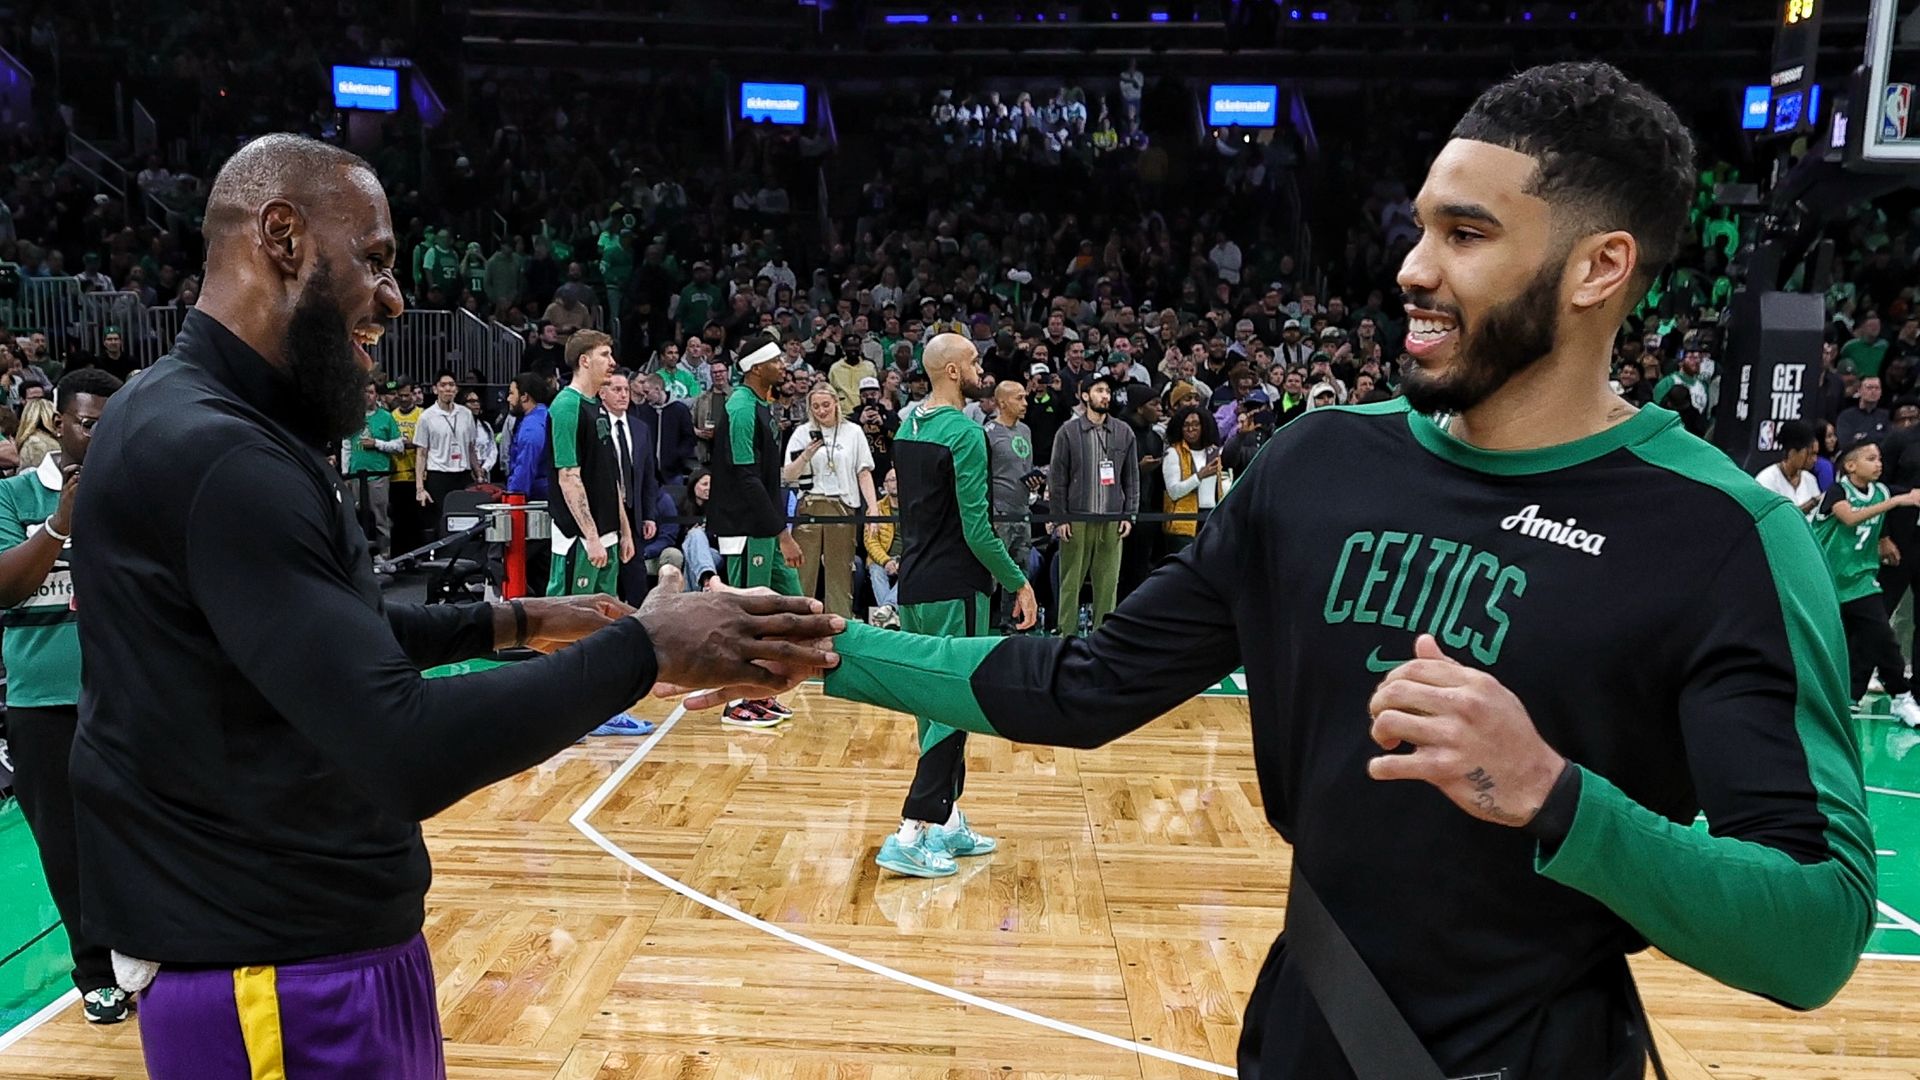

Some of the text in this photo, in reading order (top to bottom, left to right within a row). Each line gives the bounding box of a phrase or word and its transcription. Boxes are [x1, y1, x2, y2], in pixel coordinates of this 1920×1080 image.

[1772, 363, 1806, 392] GET
[1770, 392, 1803, 420] THE
[1500, 504, 1607, 556] Amica
[1854, 525, 1872, 551] 7
[1323, 531, 1527, 666] CELTICS
